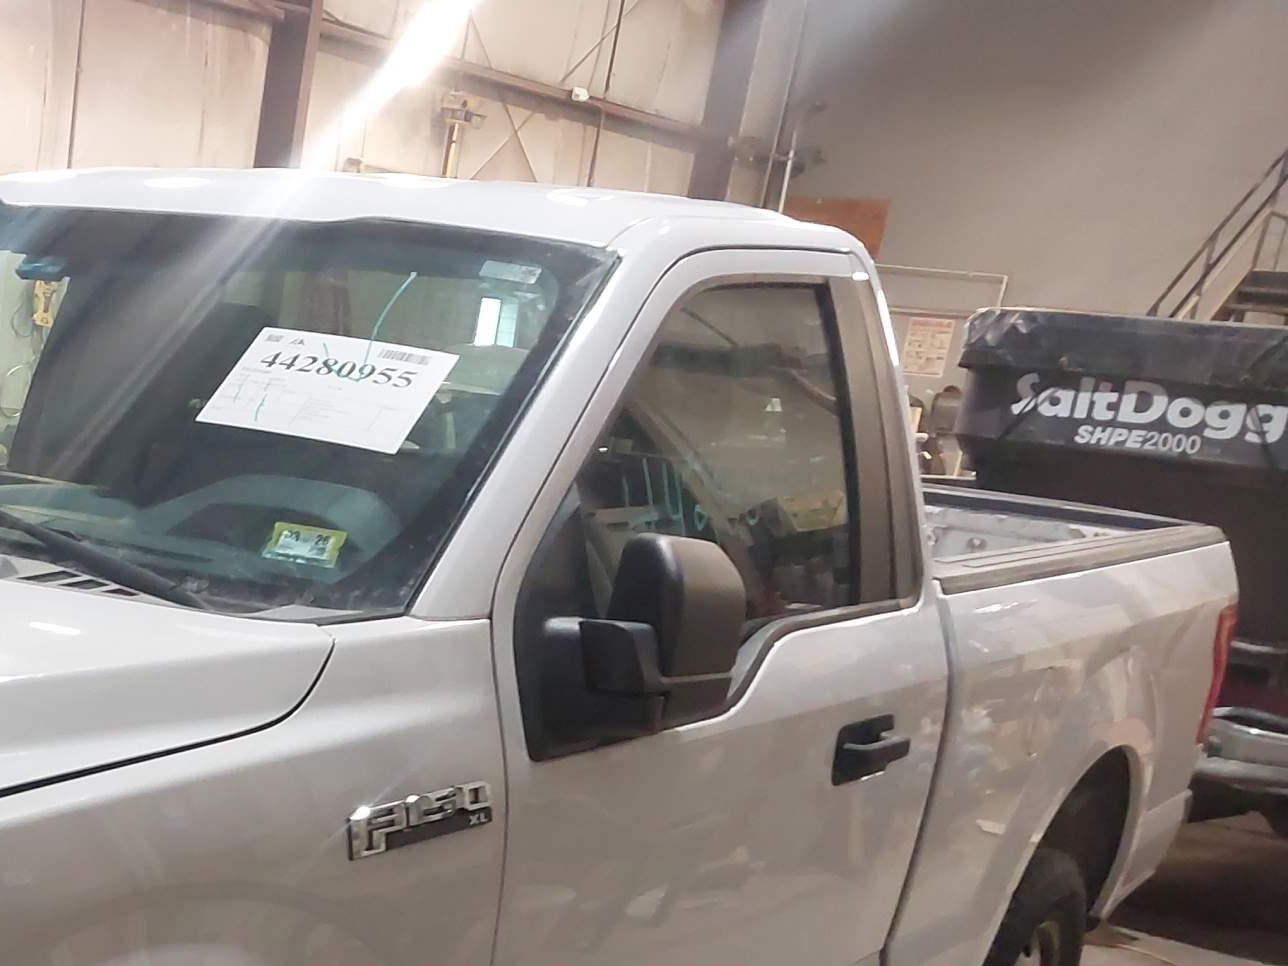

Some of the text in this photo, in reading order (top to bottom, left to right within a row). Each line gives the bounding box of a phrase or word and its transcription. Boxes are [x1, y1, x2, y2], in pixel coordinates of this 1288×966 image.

[260, 350, 417, 389] 44280955
[1011, 372, 1288, 443] SaltDogg
[1074, 425, 1201, 455] SHPE2000
[469, 813, 488, 826] XL
